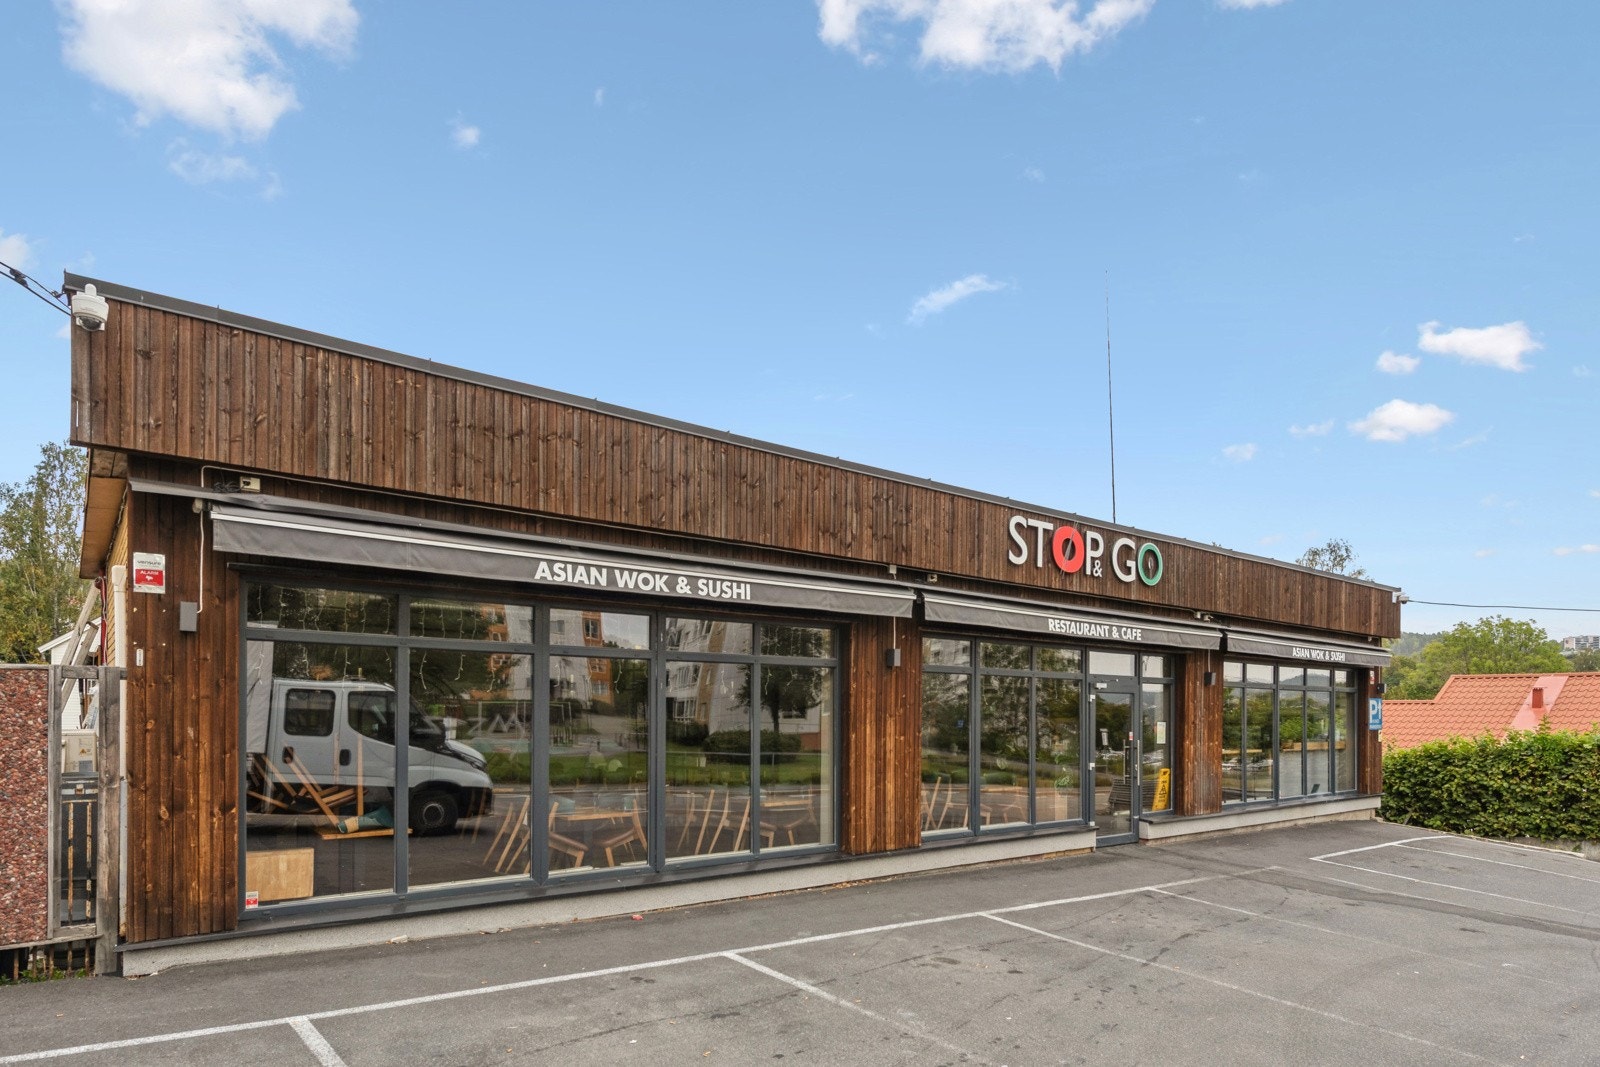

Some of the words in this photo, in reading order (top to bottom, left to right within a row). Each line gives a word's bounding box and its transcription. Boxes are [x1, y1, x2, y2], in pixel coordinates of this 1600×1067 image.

[1008, 515, 1104, 576] STOP
[1092, 559, 1103, 578] &
[1112, 537, 1164, 586] GO
[534, 561, 608, 587] ASIAN
[614, 569, 670, 593] WOK
[675, 576, 692, 595] &
[698, 579, 751, 600] SUSHI
[1048, 618, 1110, 638] RESTAURANT
[1112, 626, 1119, 639] &
[1121, 627, 1142, 640] CAFE
[1293, 647, 1310, 658] ASIAN
[1311, 649, 1324, 660] WOK
[1325, 650, 1330, 661] &
[1331, 651, 1346, 661] SUSHI
[1369, 700, 1378, 724] P
